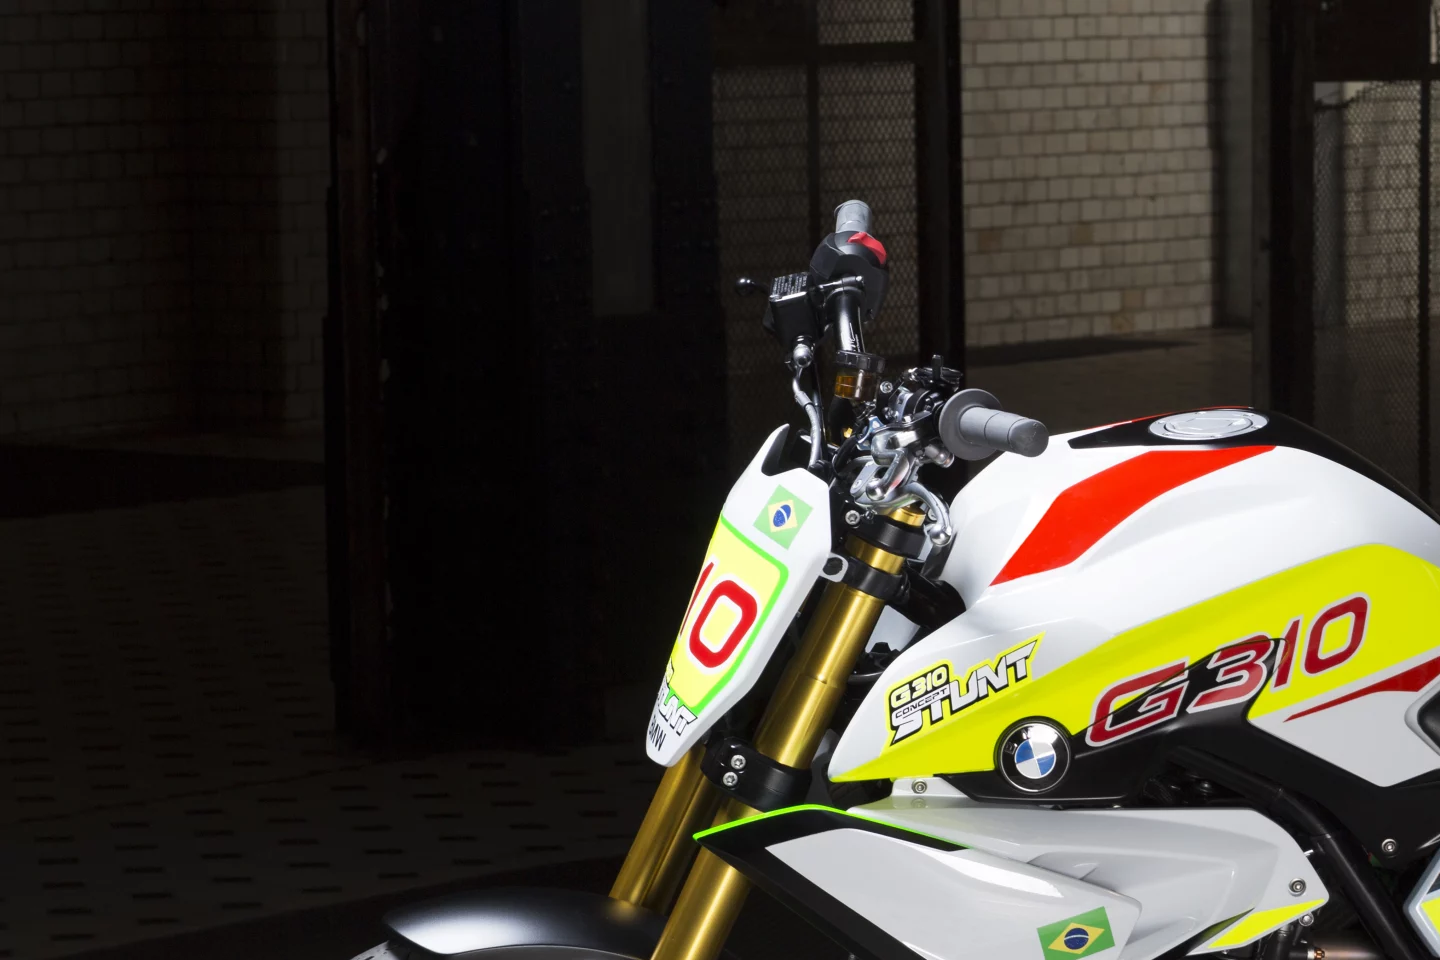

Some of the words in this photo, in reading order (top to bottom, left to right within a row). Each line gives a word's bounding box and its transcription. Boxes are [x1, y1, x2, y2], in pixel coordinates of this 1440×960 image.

[890, 665, 948, 709] G310
[890, 640, 1037, 745] STUNT
[895, 687, 948, 719] CONCEPT
[1086, 593, 1370, 746] G310
